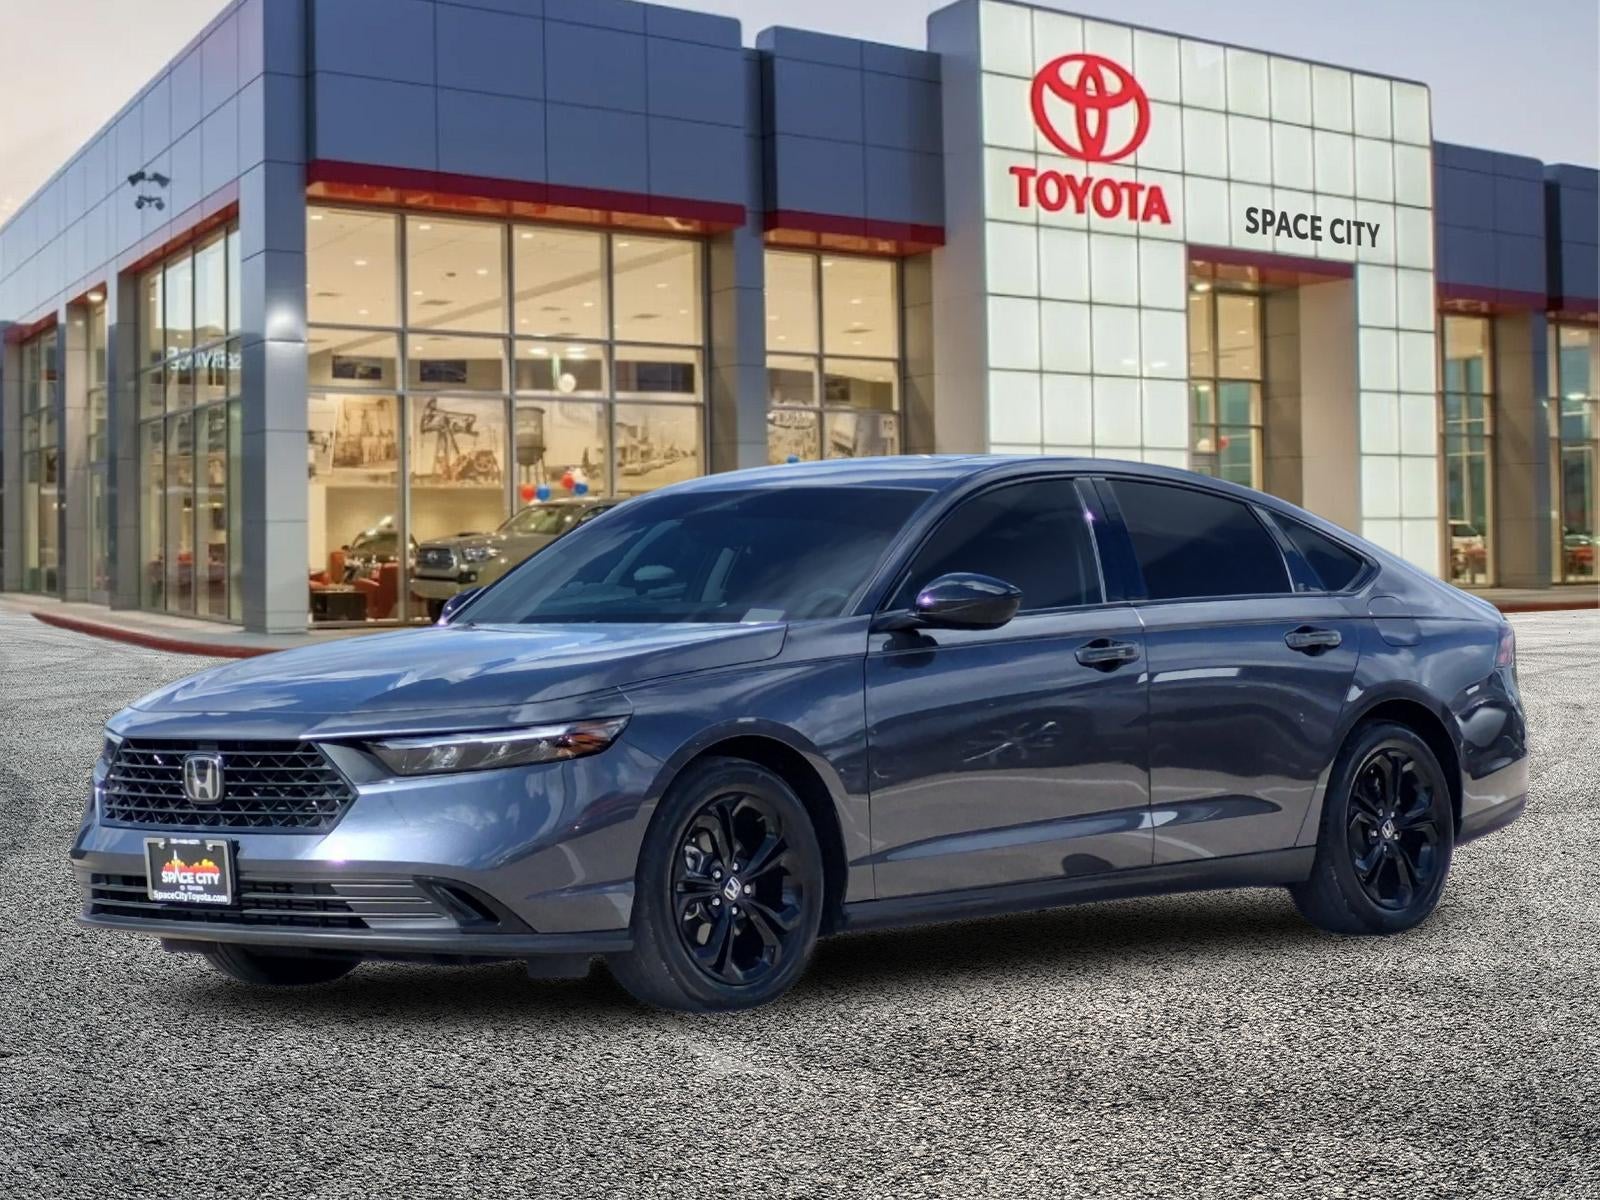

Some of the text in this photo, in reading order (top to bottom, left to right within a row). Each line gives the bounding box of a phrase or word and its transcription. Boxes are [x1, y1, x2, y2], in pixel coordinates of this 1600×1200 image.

[1009, 166, 1171, 224] TOYOTA
[1245, 206, 1381, 248] SPACE CITY
[161, 870, 220, 885] SPACE CITY
[153, 889, 228, 902] SpaceCityToyota.com
